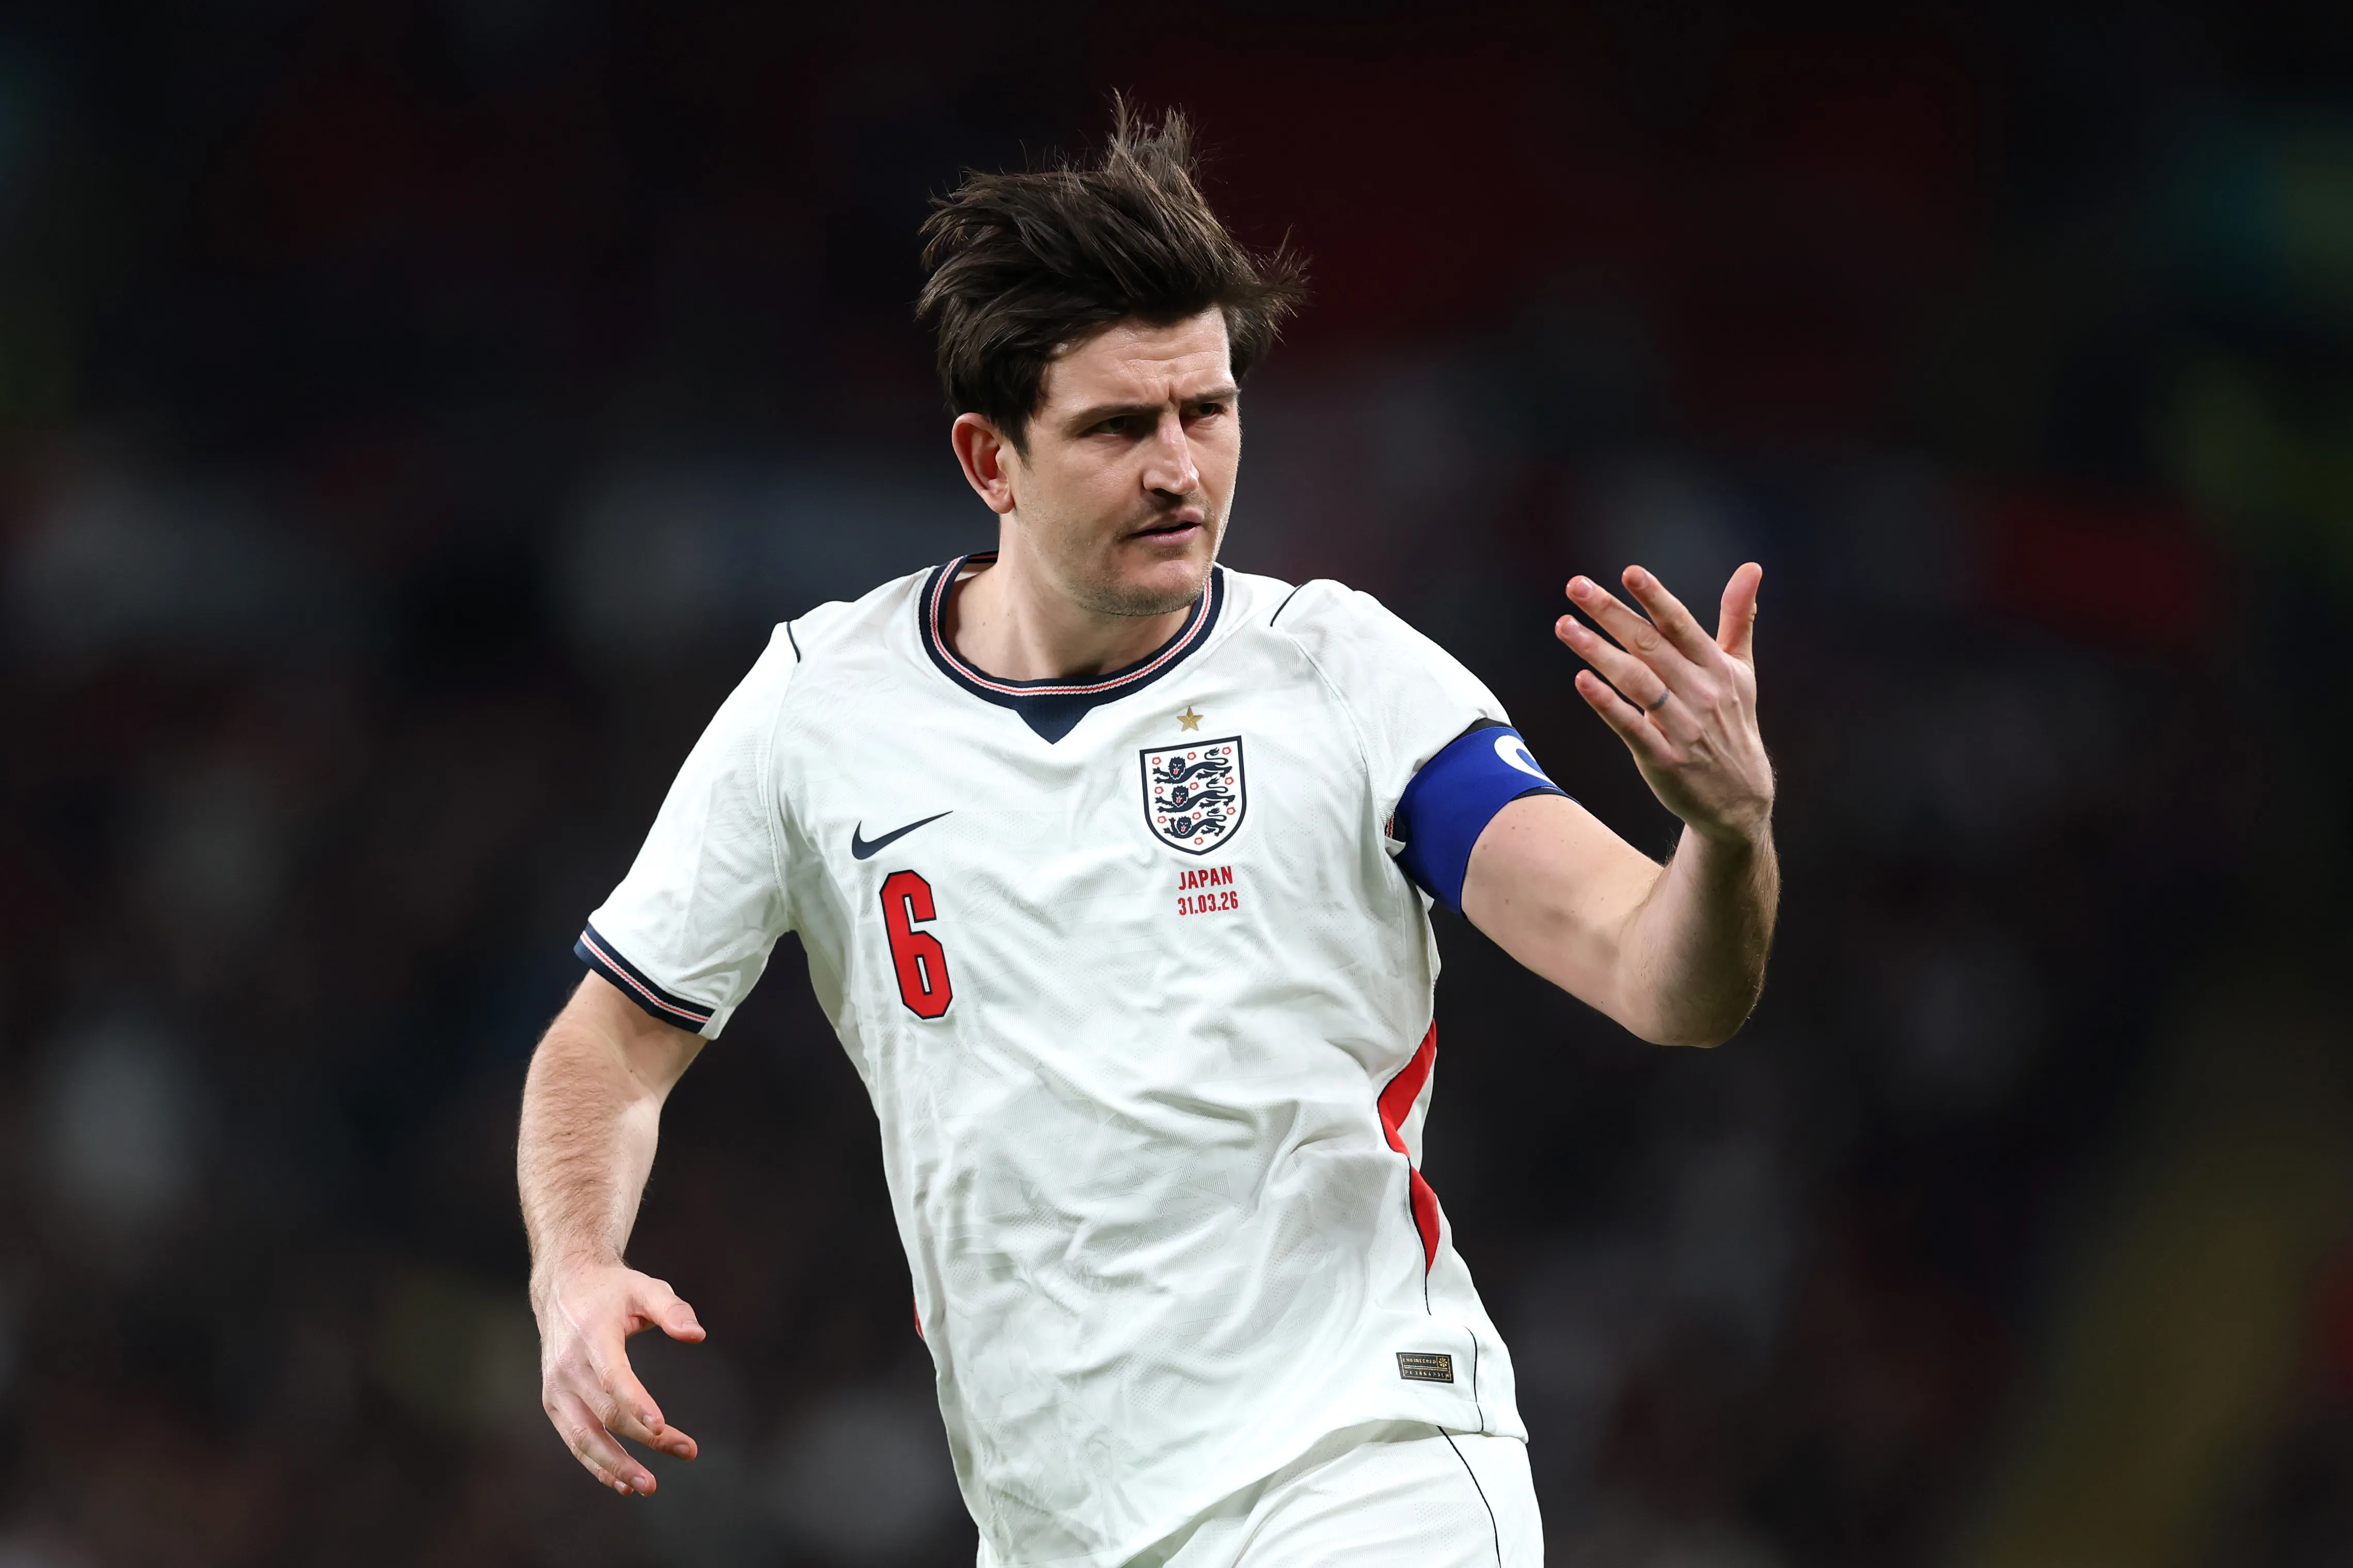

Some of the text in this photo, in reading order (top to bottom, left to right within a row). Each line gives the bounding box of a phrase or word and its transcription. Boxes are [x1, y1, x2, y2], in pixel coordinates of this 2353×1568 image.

[1178, 866, 1233, 890] JAPAN
[1177, 891, 1239, 916] 31.03.26
[879, 869, 953, 1020] 6
